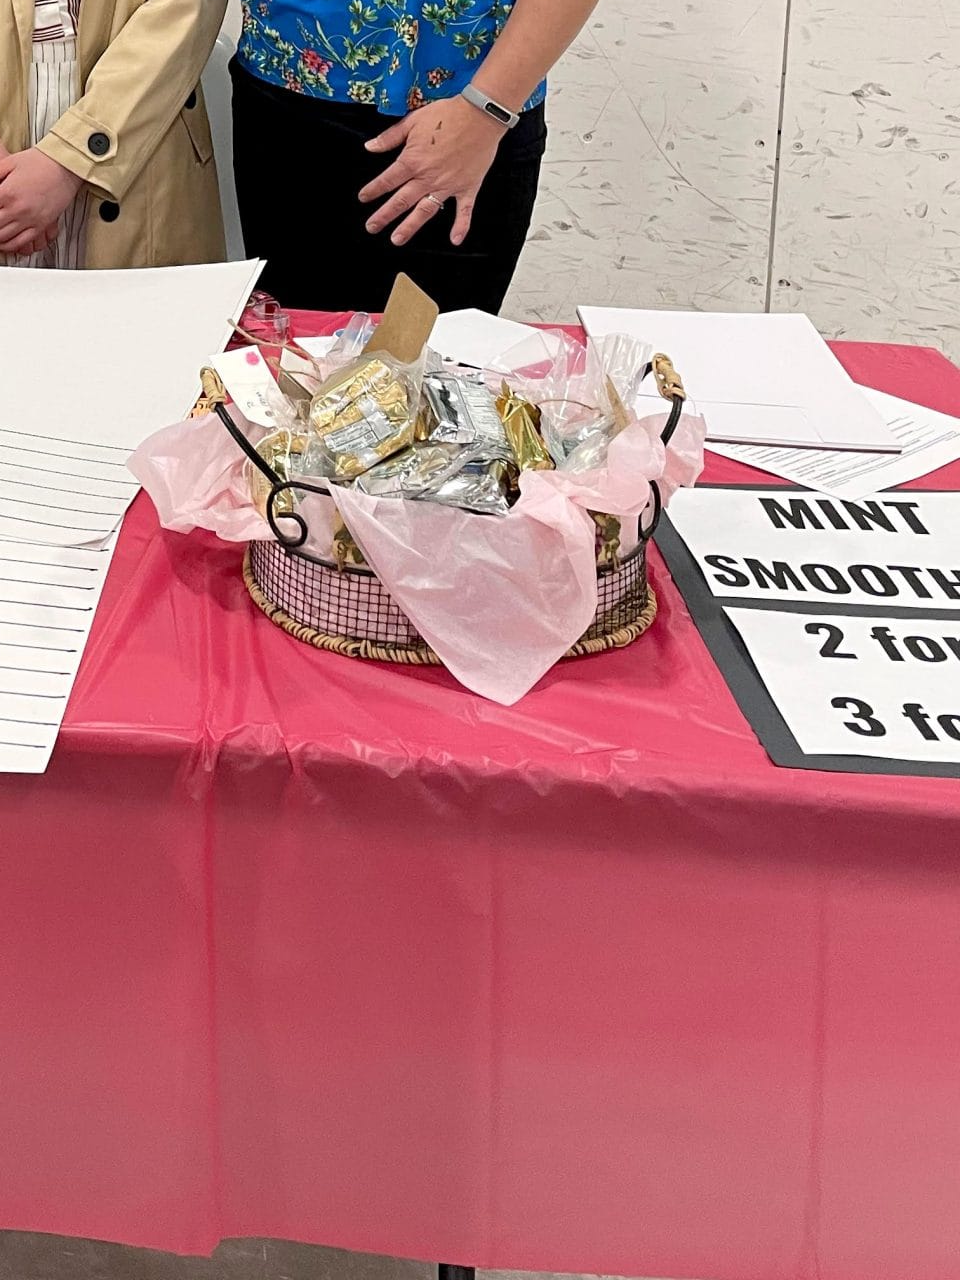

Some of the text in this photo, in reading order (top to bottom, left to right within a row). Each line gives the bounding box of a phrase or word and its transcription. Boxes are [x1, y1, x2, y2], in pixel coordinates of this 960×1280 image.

[758, 497, 930, 535] MINT
[804, 622, 858, 660] 2
[830, 696, 886, 737] 3
